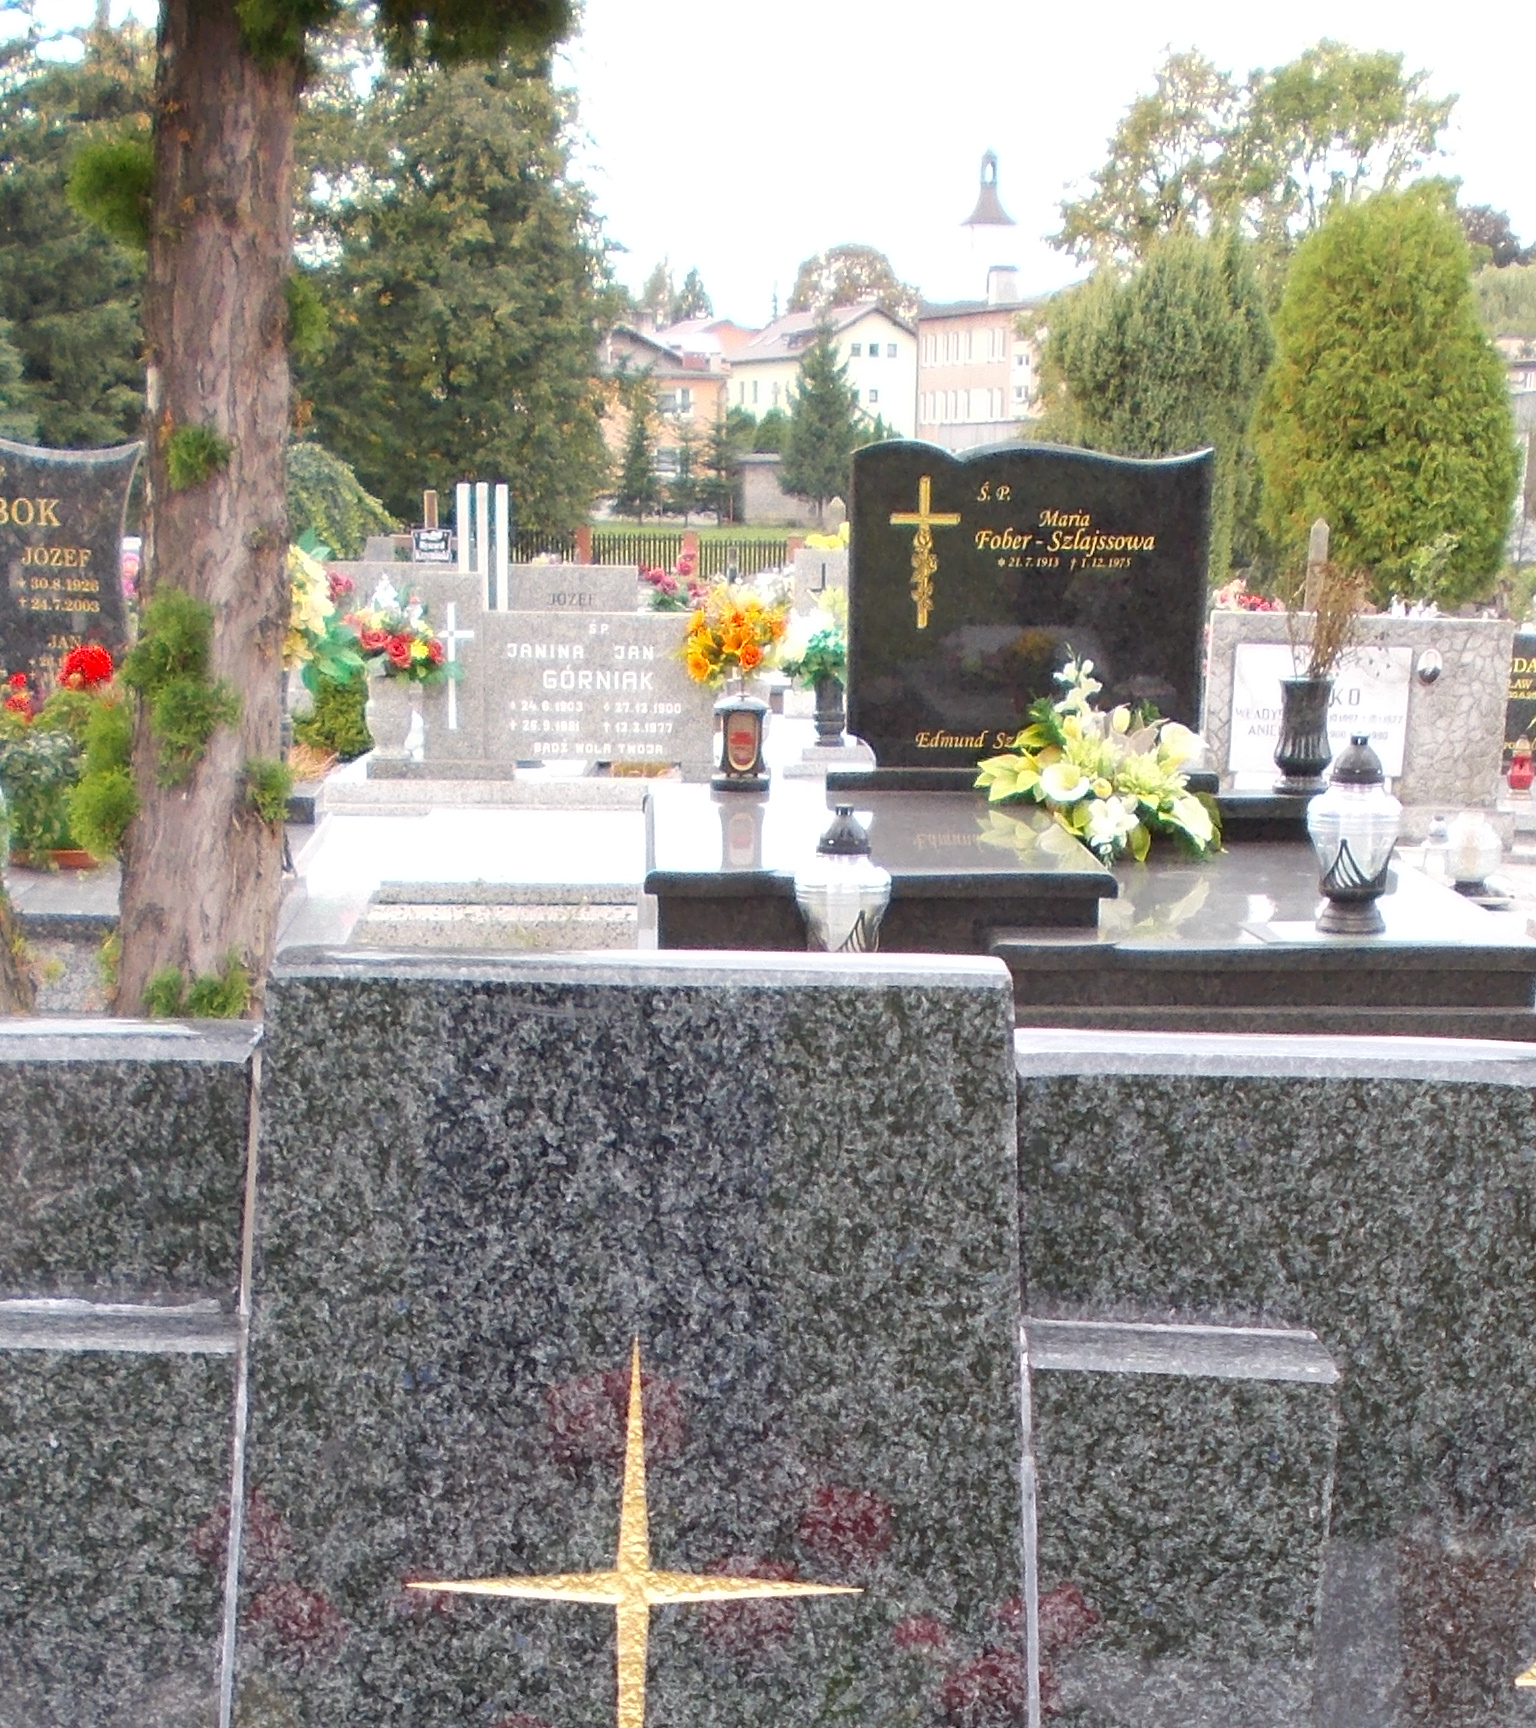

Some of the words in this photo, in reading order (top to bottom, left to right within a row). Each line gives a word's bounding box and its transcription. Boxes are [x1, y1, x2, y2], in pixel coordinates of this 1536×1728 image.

[1039, 509, 1092, 528] Maria
[975, 527, 1033, 550] Fober
[506, 643, 585, 660] JANINA
[613, 645, 655, 660] JAN
[542, 665, 654, 690] GÓRNIAK
[915, 729, 989, 748] Edmund
[575, 742, 612, 754] WOLA
[618, 743, 663, 755] TWOJA
